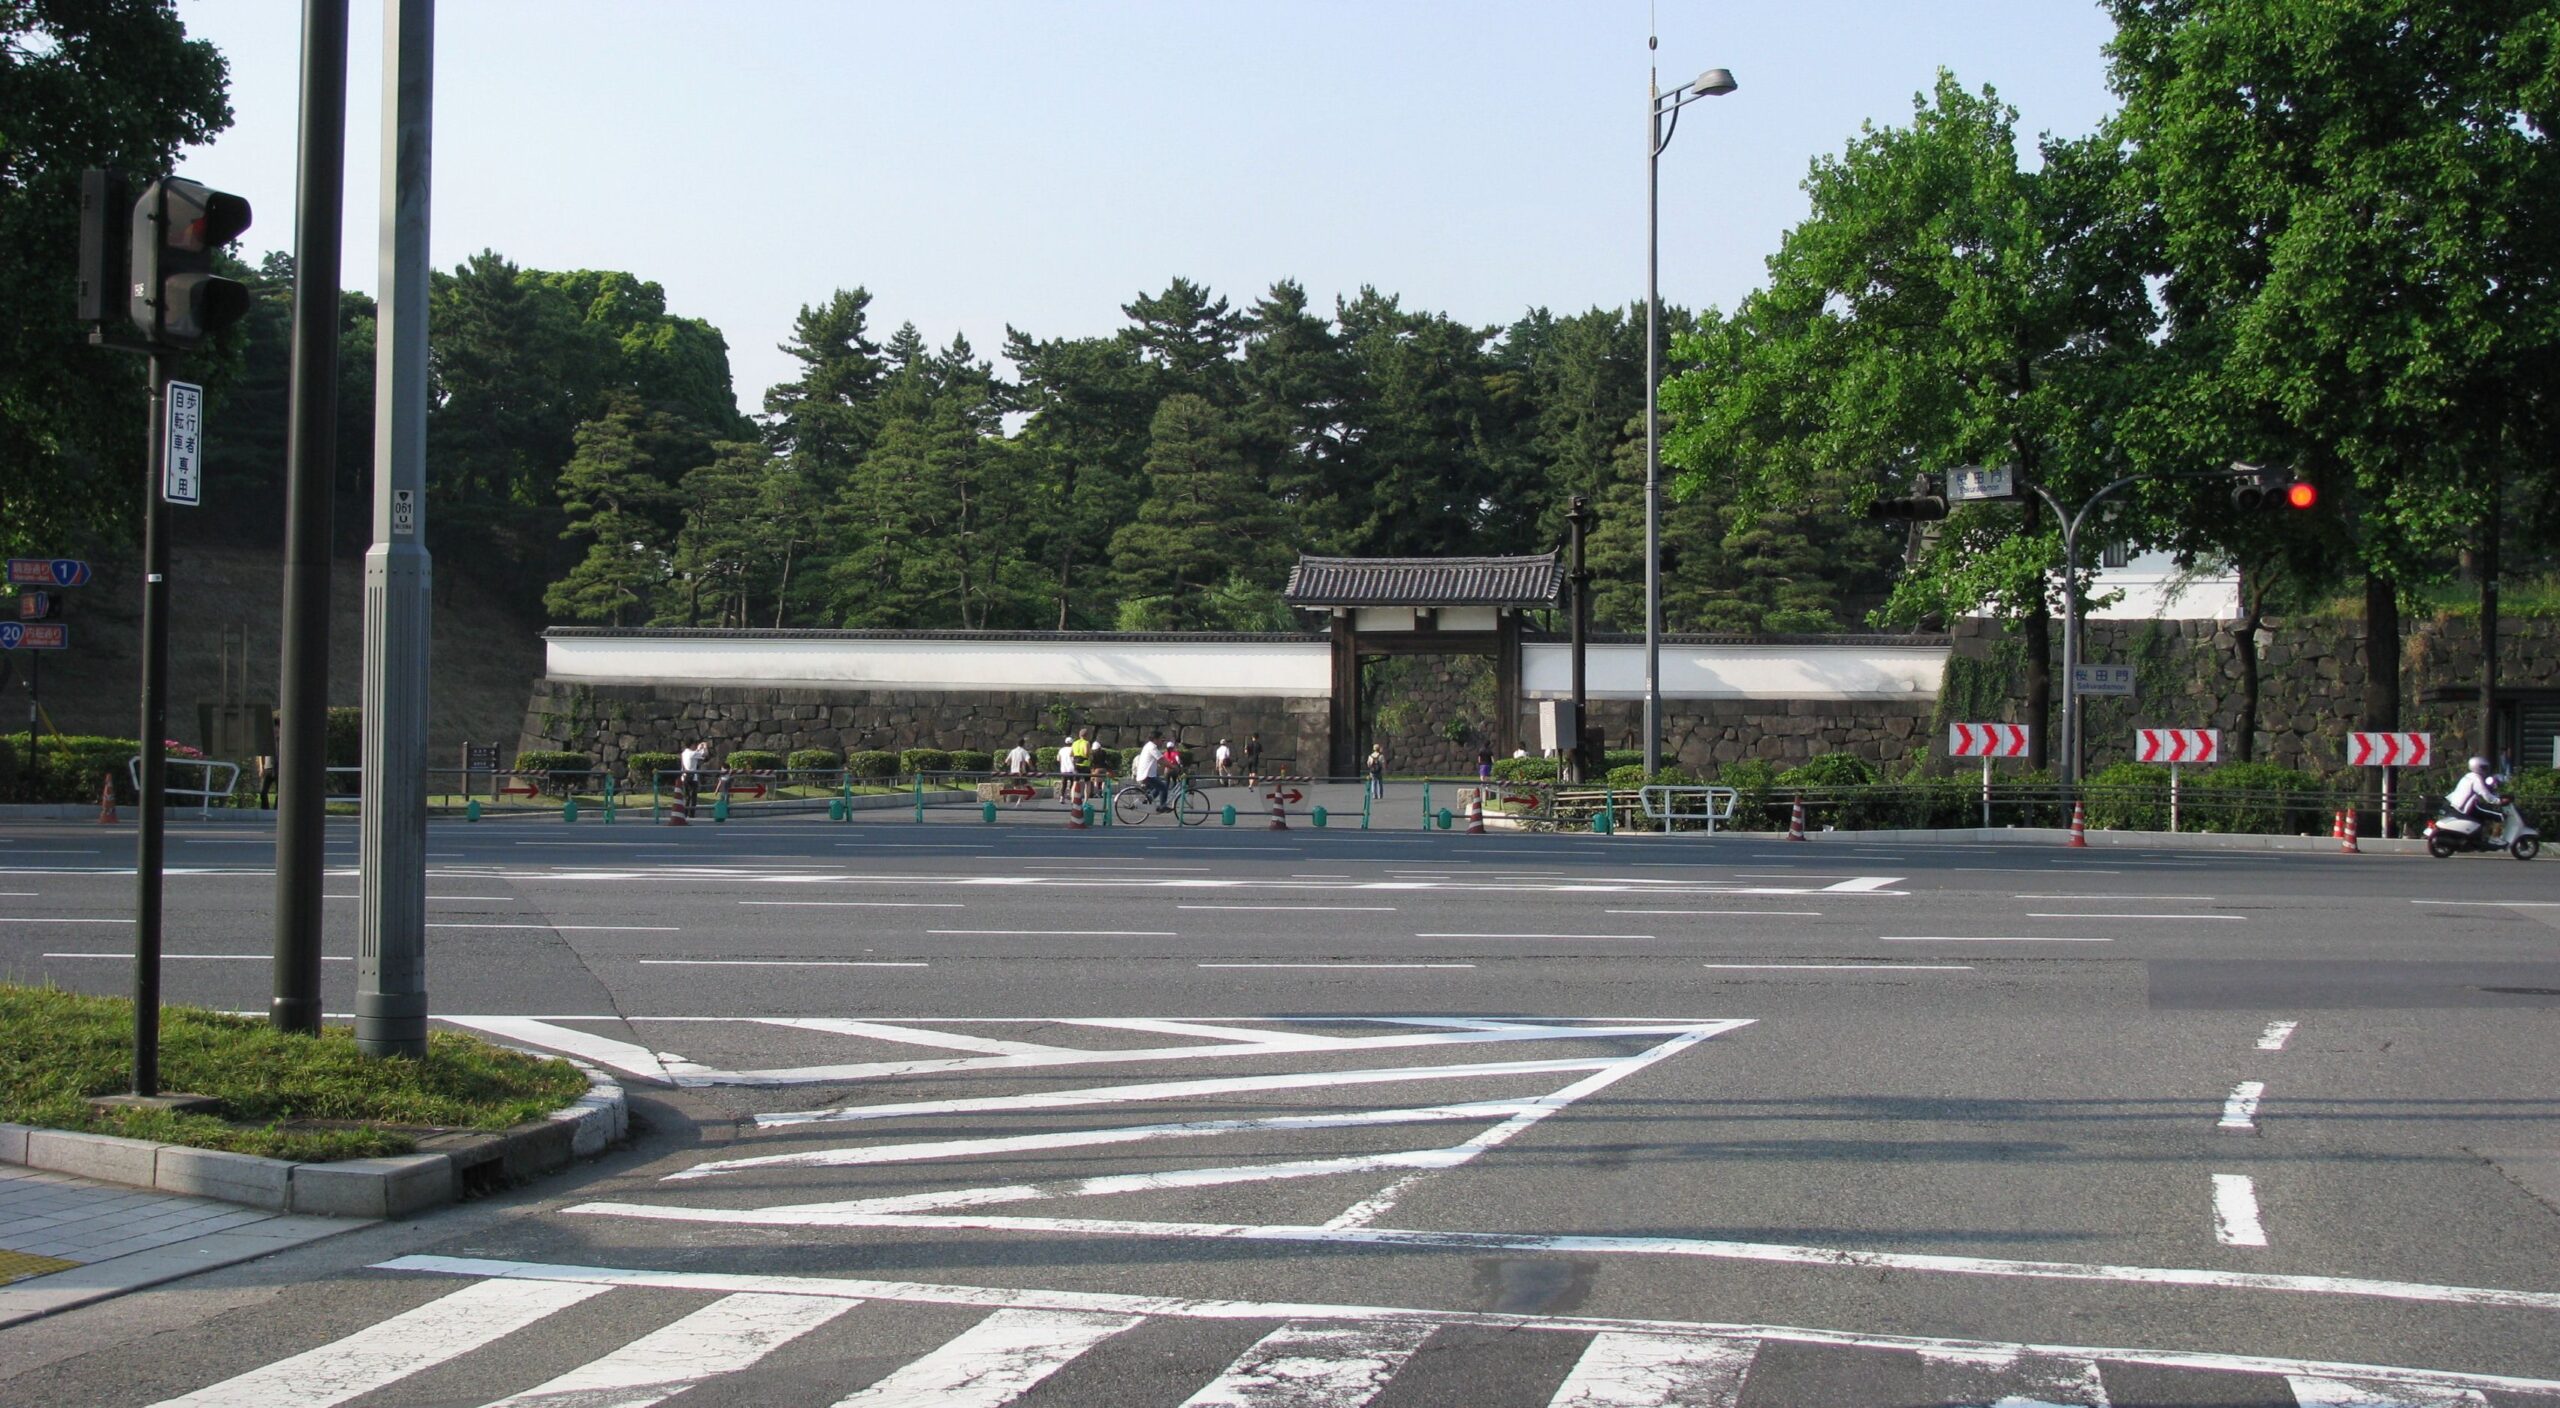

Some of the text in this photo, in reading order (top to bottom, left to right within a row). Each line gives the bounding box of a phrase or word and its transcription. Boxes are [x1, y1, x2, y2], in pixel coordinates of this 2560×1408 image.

[173, 391, 185, 451] 自転車
[186, 393, 197, 454] 歩行者
[178, 456, 189, 496] 専用
[395, 502, 412, 514] 061
[61, 563, 68, 579] 1
[3, 626, 21, 641] 20
[2076, 669, 2129, 682] 桜田門
